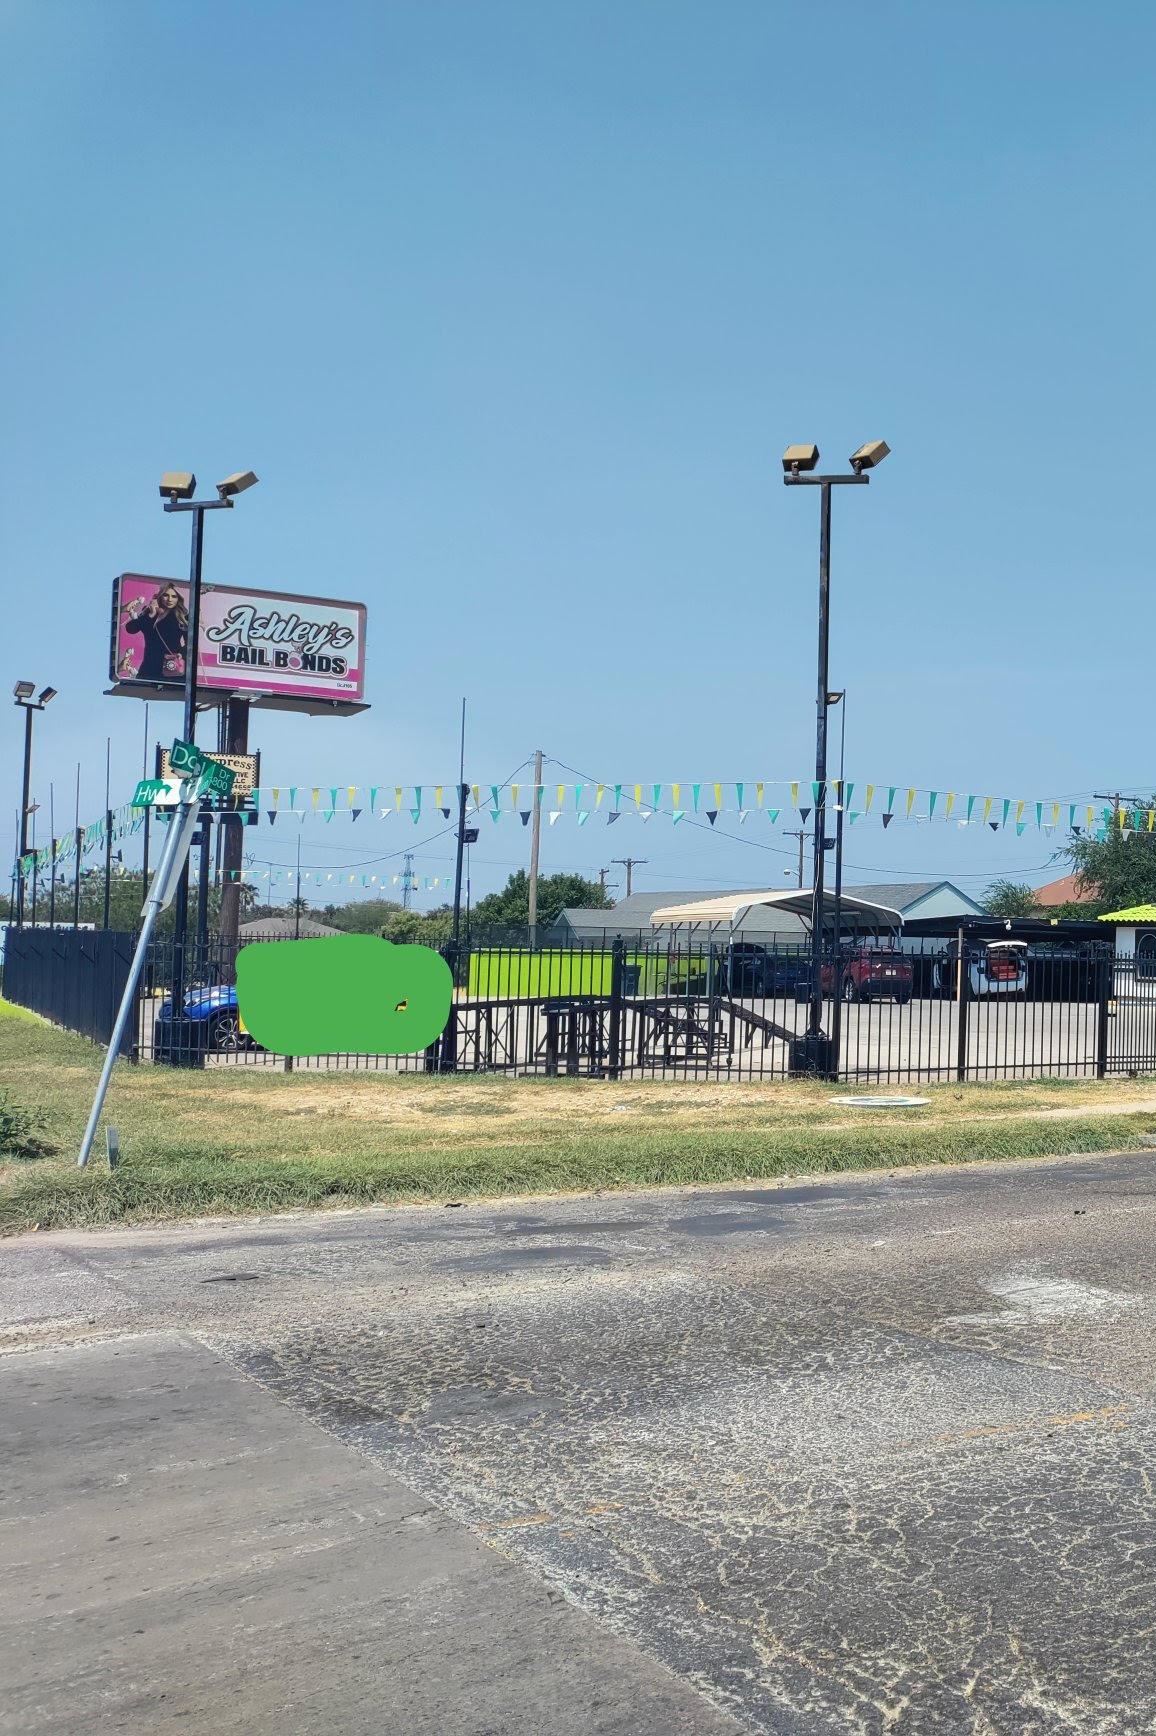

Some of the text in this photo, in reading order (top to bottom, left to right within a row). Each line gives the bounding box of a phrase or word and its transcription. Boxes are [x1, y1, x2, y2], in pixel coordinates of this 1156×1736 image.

[205, 604, 355, 655] Ashley's
[220, 644, 348, 676] BAIL BONDS
[216, 758, 253, 770] press
[219, 769, 231, 781] Dr
[209, 776, 228, 791] 800
